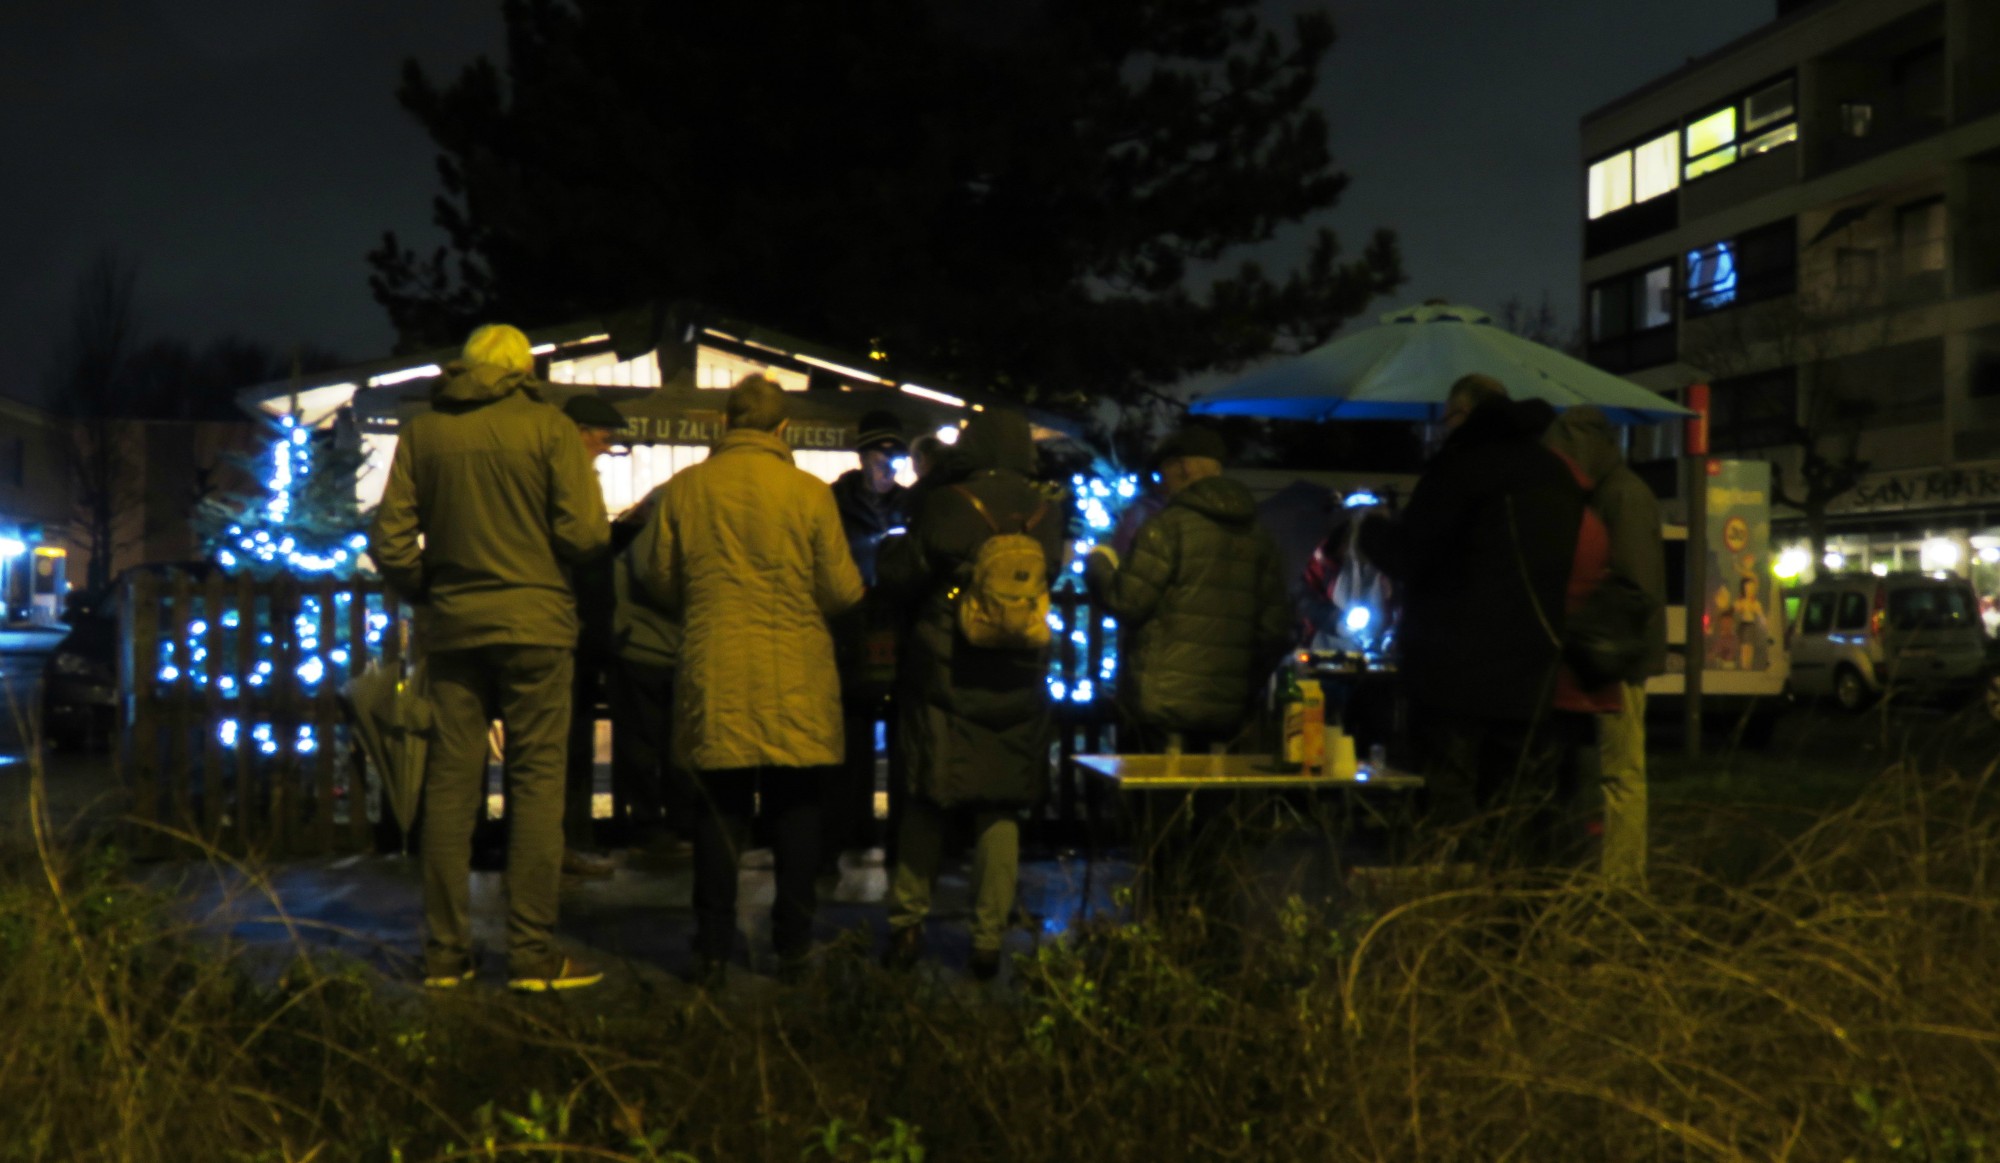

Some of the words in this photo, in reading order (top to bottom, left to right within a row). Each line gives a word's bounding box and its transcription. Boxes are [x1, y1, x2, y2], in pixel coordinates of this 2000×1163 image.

[656, 418, 670, 439] U
[678, 419, 726, 441] ZALI
[1854, 478, 1914, 505] SAN
